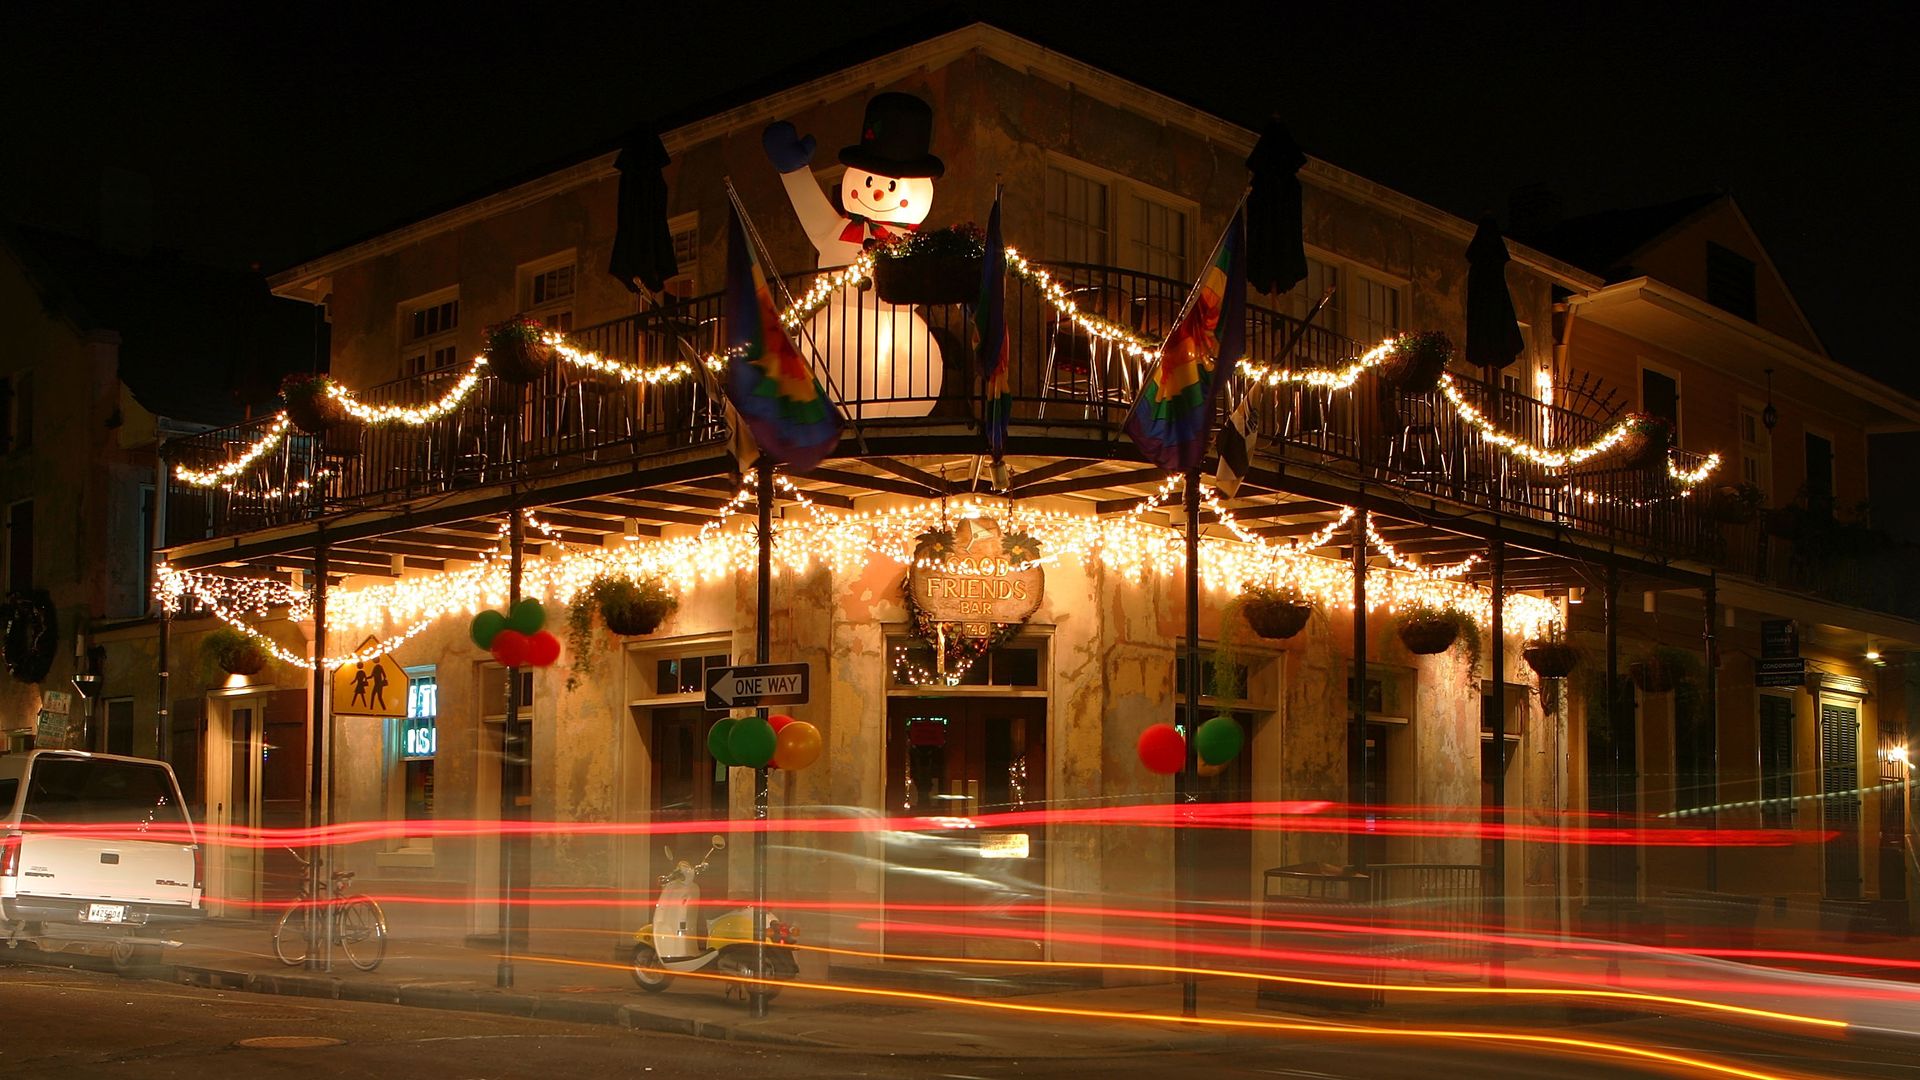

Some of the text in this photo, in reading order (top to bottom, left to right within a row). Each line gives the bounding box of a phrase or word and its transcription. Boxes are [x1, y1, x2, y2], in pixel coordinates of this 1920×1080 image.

[946, 556, 1009, 577] GOOD
[927, 577, 1027, 600] FRIENDS
[960, 602, 992, 614] BAR
[966, 624, 988, 636] 740
[735, 676, 798, 695] ONE WAY
